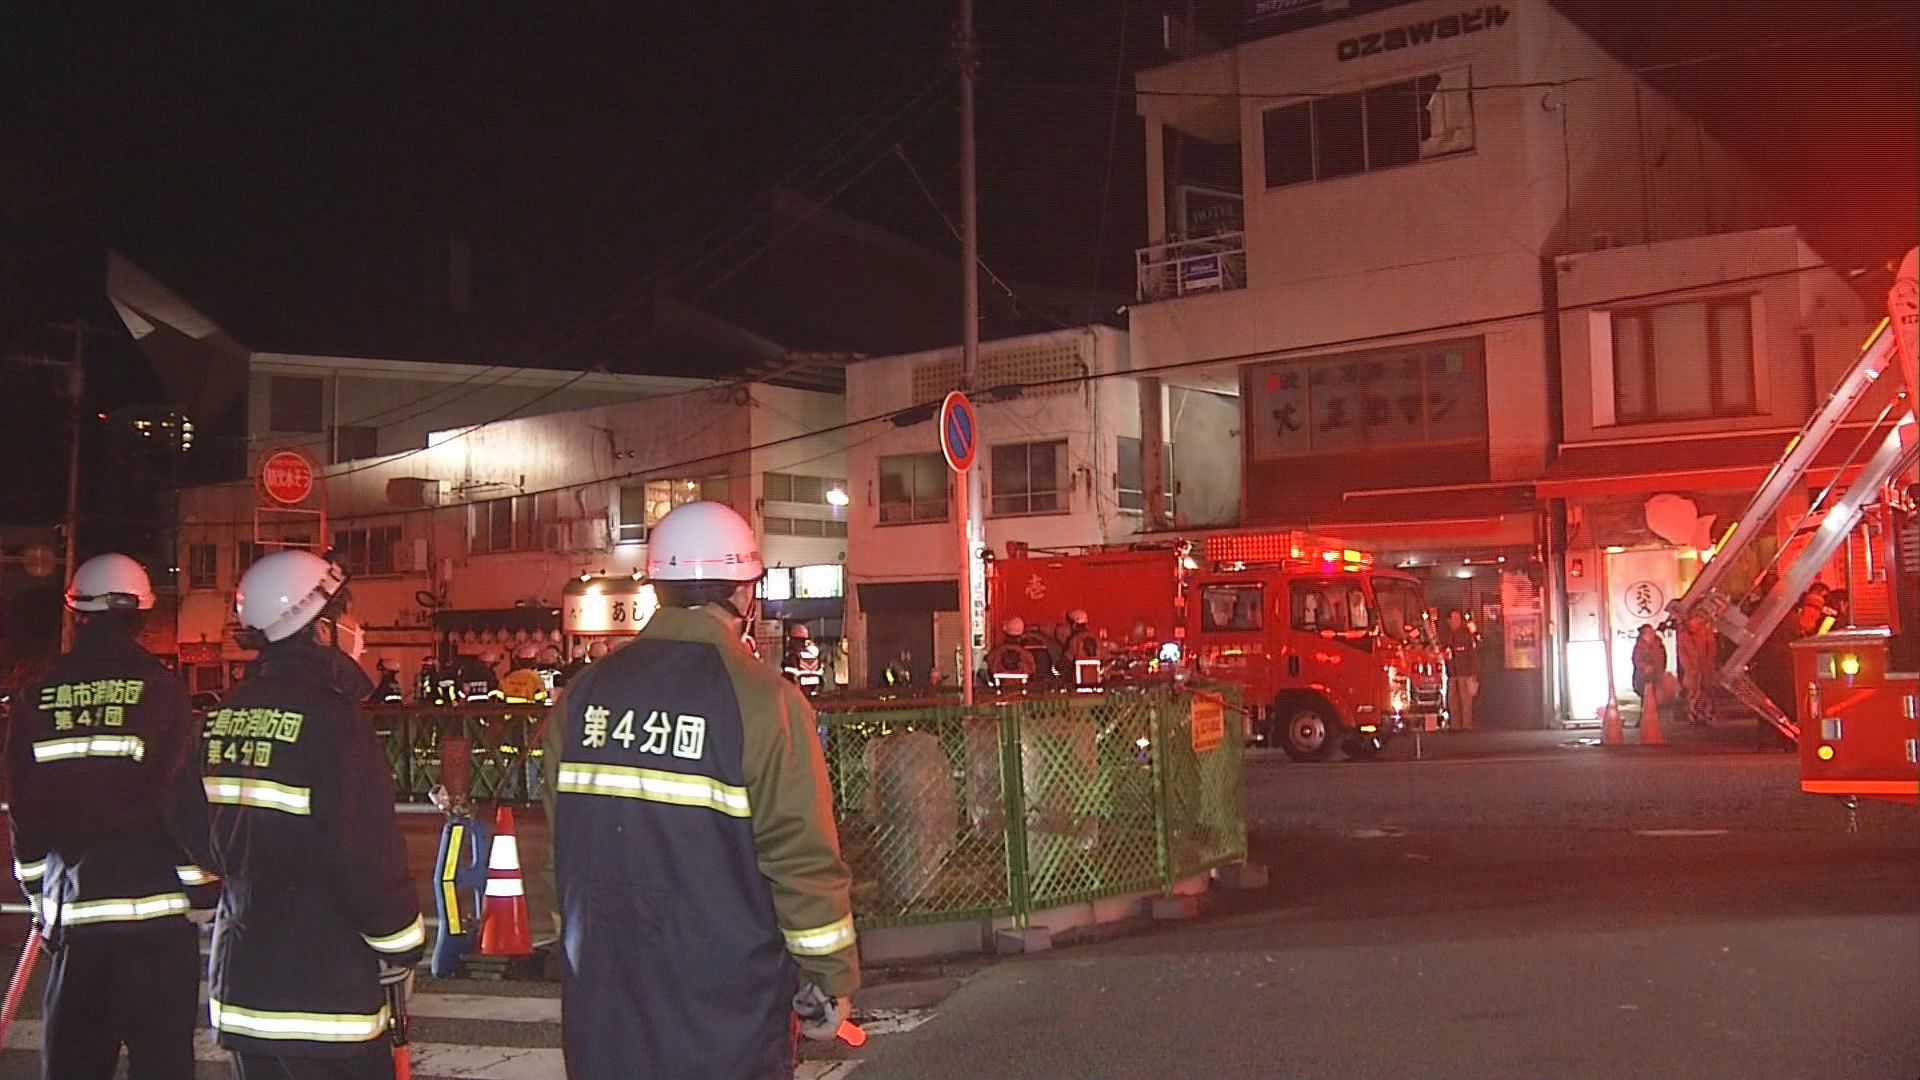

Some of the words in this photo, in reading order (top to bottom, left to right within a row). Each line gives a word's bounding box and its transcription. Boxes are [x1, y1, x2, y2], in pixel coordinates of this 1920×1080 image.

[38, 679, 145, 710] 三島市消防団
[203, 708, 303, 743] 三島市消防団
[581, 705, 707, 760] 第4分団
[207, 739, 273, 767] 第4分団
